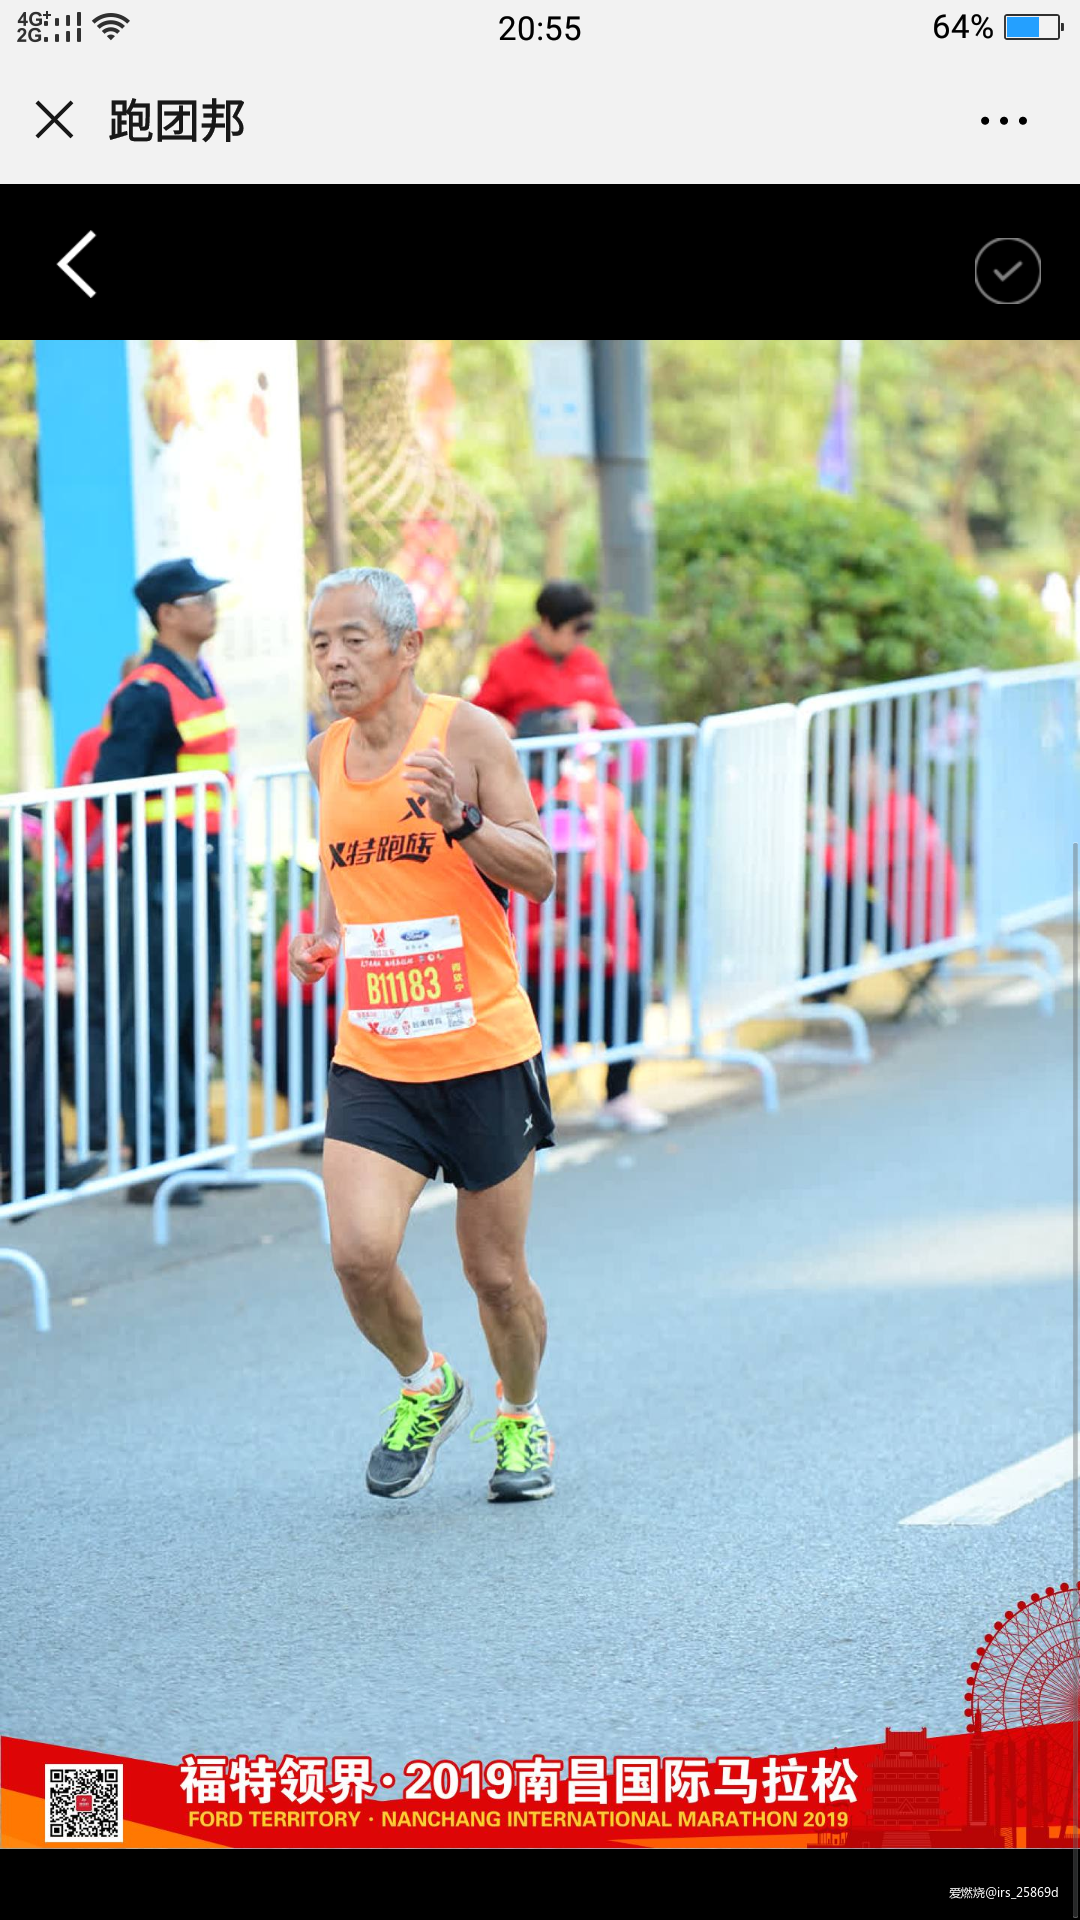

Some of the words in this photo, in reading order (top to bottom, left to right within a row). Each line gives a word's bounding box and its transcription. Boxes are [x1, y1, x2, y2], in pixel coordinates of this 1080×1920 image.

[17, 28, 42, 42] 2G
[499, 16, 581, 42] 20:55
[933, 13, 994, 40] 64%
[109, 98, 245, 143] 跑团邦
[367, 966, 441, 1004] B11183
